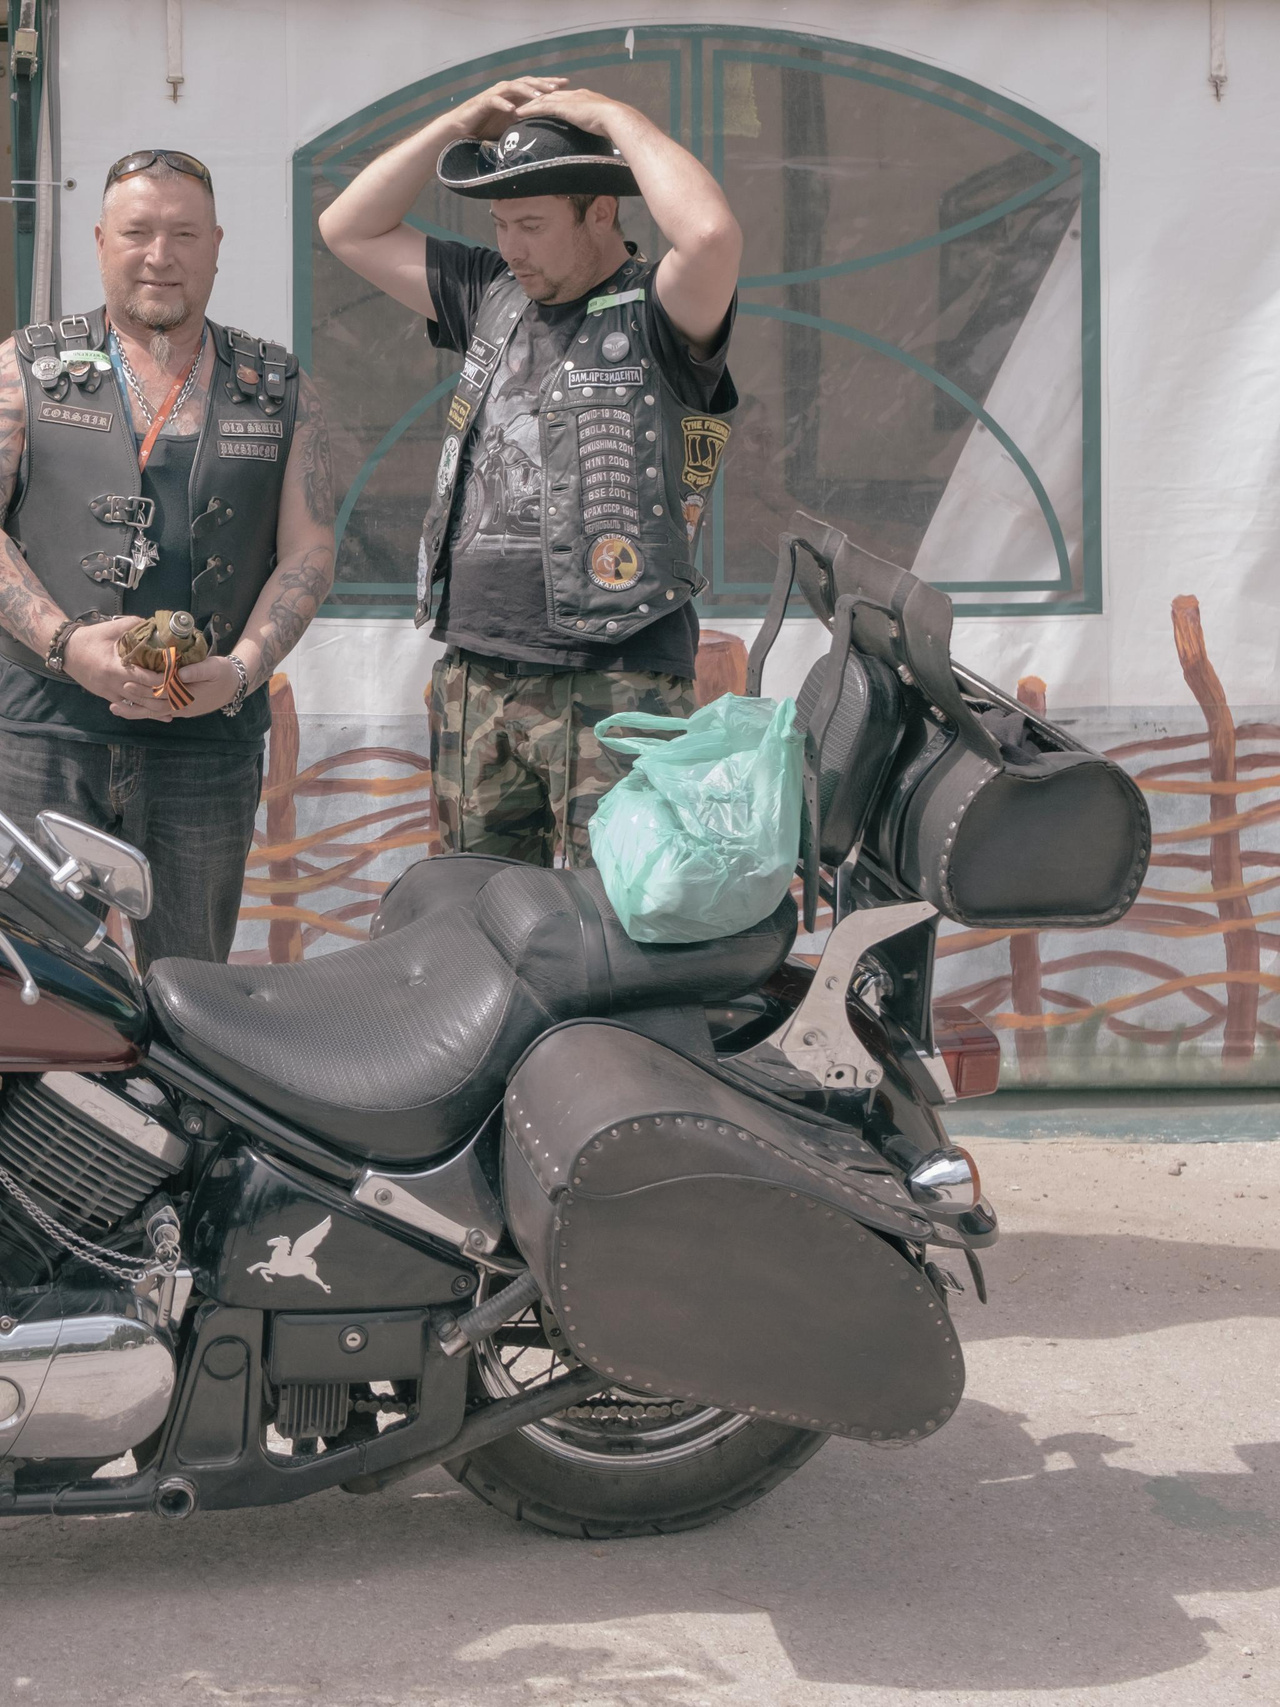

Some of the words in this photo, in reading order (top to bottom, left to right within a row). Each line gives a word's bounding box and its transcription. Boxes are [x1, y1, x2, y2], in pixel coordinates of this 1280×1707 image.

[42, 407, 108, 427] CORSAIR
[578, 408, 610, 424] COVID-19
[613, 409, 631, 423] 2020
[222, 422, 245, 434] OLD
[580, 424, 607, 439] EBOLA
[609, 424, 631, 439] 2014
[685, 420, 703, 431] THE
[220, 442, 276, 458] PRESIDENT
[579, 440, 617, 457] FUKUSHIMA
[618, 441, 634, 456] 2011
[585, 456, 606, 470] H1N1
[608, 455, 630, 469] 2009
[609, 471, 631, 484] 2007
[588, 487, 607, 501] BSE
[608, 487, 631, 500] 2001
[583, 504, 602, 520] КРАХ
[602, 503, 621, 514] СССР
[621, 505, 638, 520] 1991
[584, 519, 621, 533] ЧЕРНОБЫЛЬ
[597, 533, 632, 545] ВЕТЕРАН
